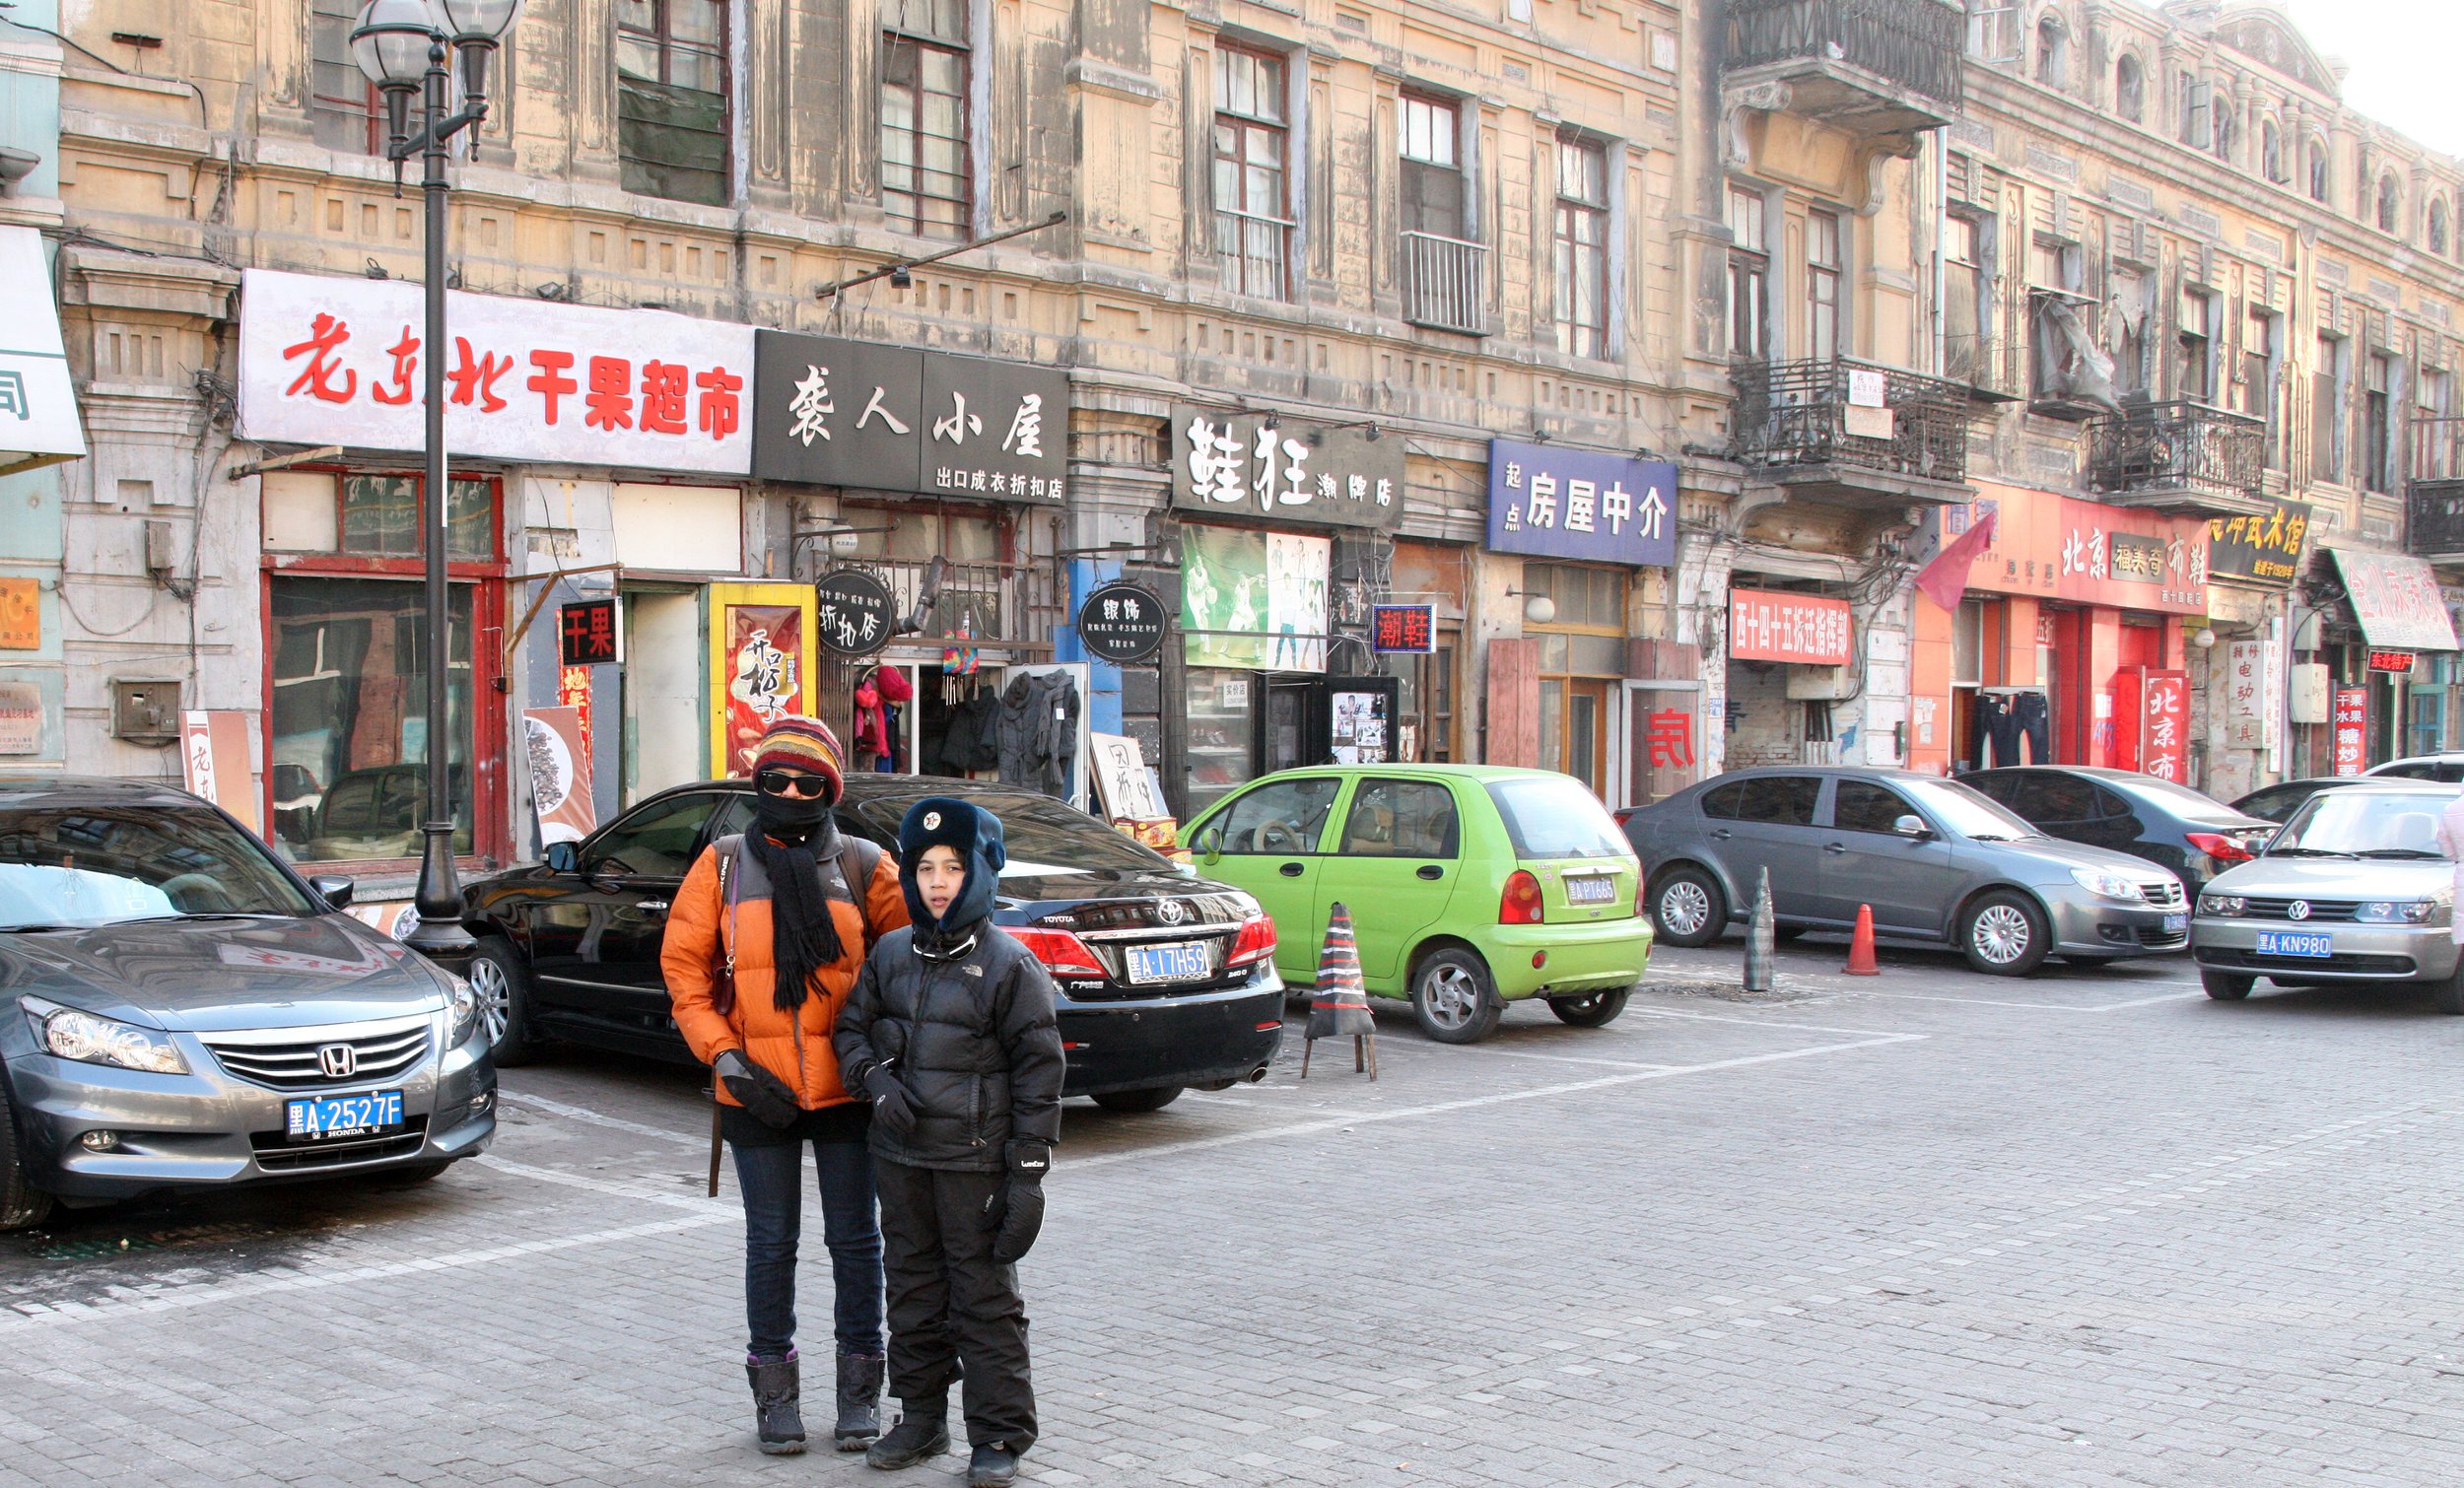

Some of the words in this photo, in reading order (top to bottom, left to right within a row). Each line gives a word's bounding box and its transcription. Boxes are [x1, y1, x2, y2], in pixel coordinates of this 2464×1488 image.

[283, 312, 743, 440] 老东北干果超市
[788, 365, 1043, 458] 袭人小屋
[936, 466, 1063, 500] 出口成衣折扣店
[1187, 417, 1313, 511] 鞋狂
[1317, 473, 1392, 507] 潮牌店
[1504, 461, 1522, 532] 起点
[1527, 472, 1668, 540] 房屋中介
[2062, 527, 2107, 580] 北京
[2166, 533, 2208, 586] 布鞋
[565, 605, 613, 659] 干果
[819, 604, 881, 647] 折扣店
[1103, 598, 1139, 621] 银饰
[1378, 609, 1429, 648] 潮鞋
[1735, 601, 1848, 658] 西十四十五拆迁指挥部
[740, 631, 788, 722] 开口松子
[2371, 652, 2413, 670] 东北特产
[2236, 661, 2254, 742] 电动工具
[2336, 694, 2363, 707] 干果
[2336, 710, 2363, 722] 水果
[2259, 933, 2330, 955] 黑A·KN980
[290, 1095, 401, 1135] 黑A·2527F
[327, 1128, 366, 1137] HONDA
